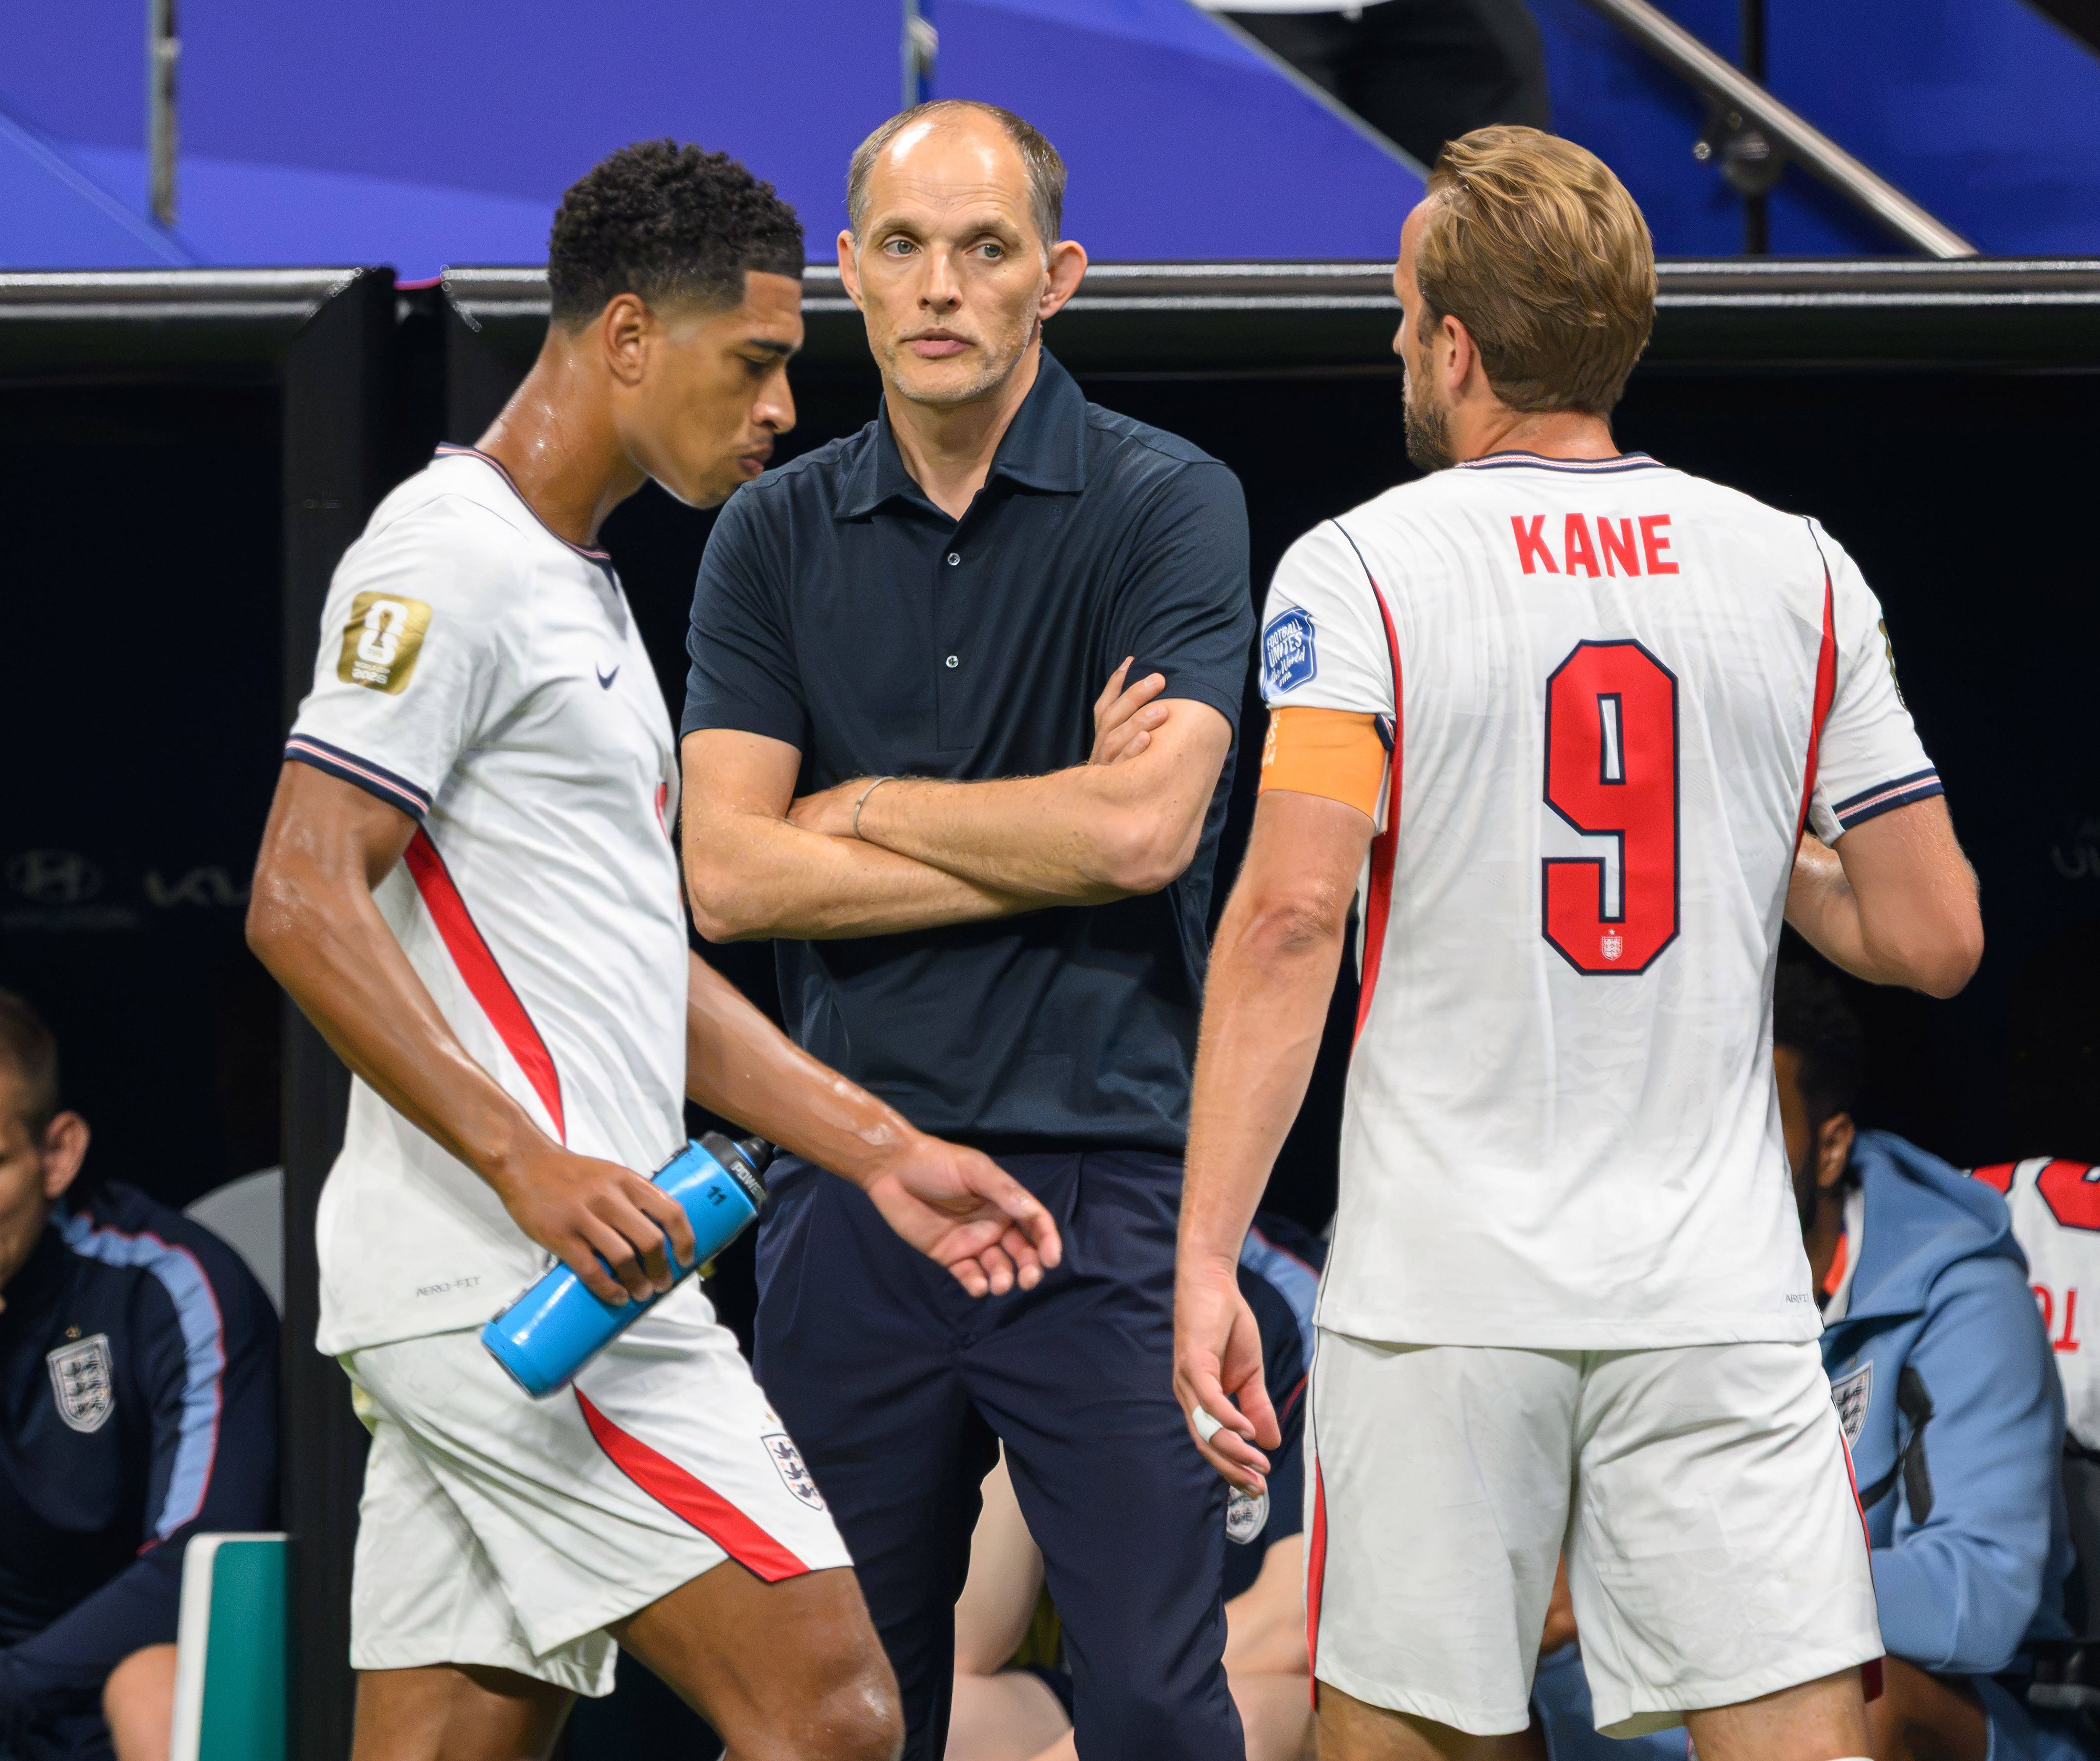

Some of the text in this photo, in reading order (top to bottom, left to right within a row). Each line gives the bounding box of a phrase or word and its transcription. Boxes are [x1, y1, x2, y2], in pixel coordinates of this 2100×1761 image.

[1510, 512, 1679, 578] KANE
[1266, 619, 1303, 650] FOOTBALL
[1268, 632, 1303, 668] UNITES
[1542, 638, 1679, 976] 9
